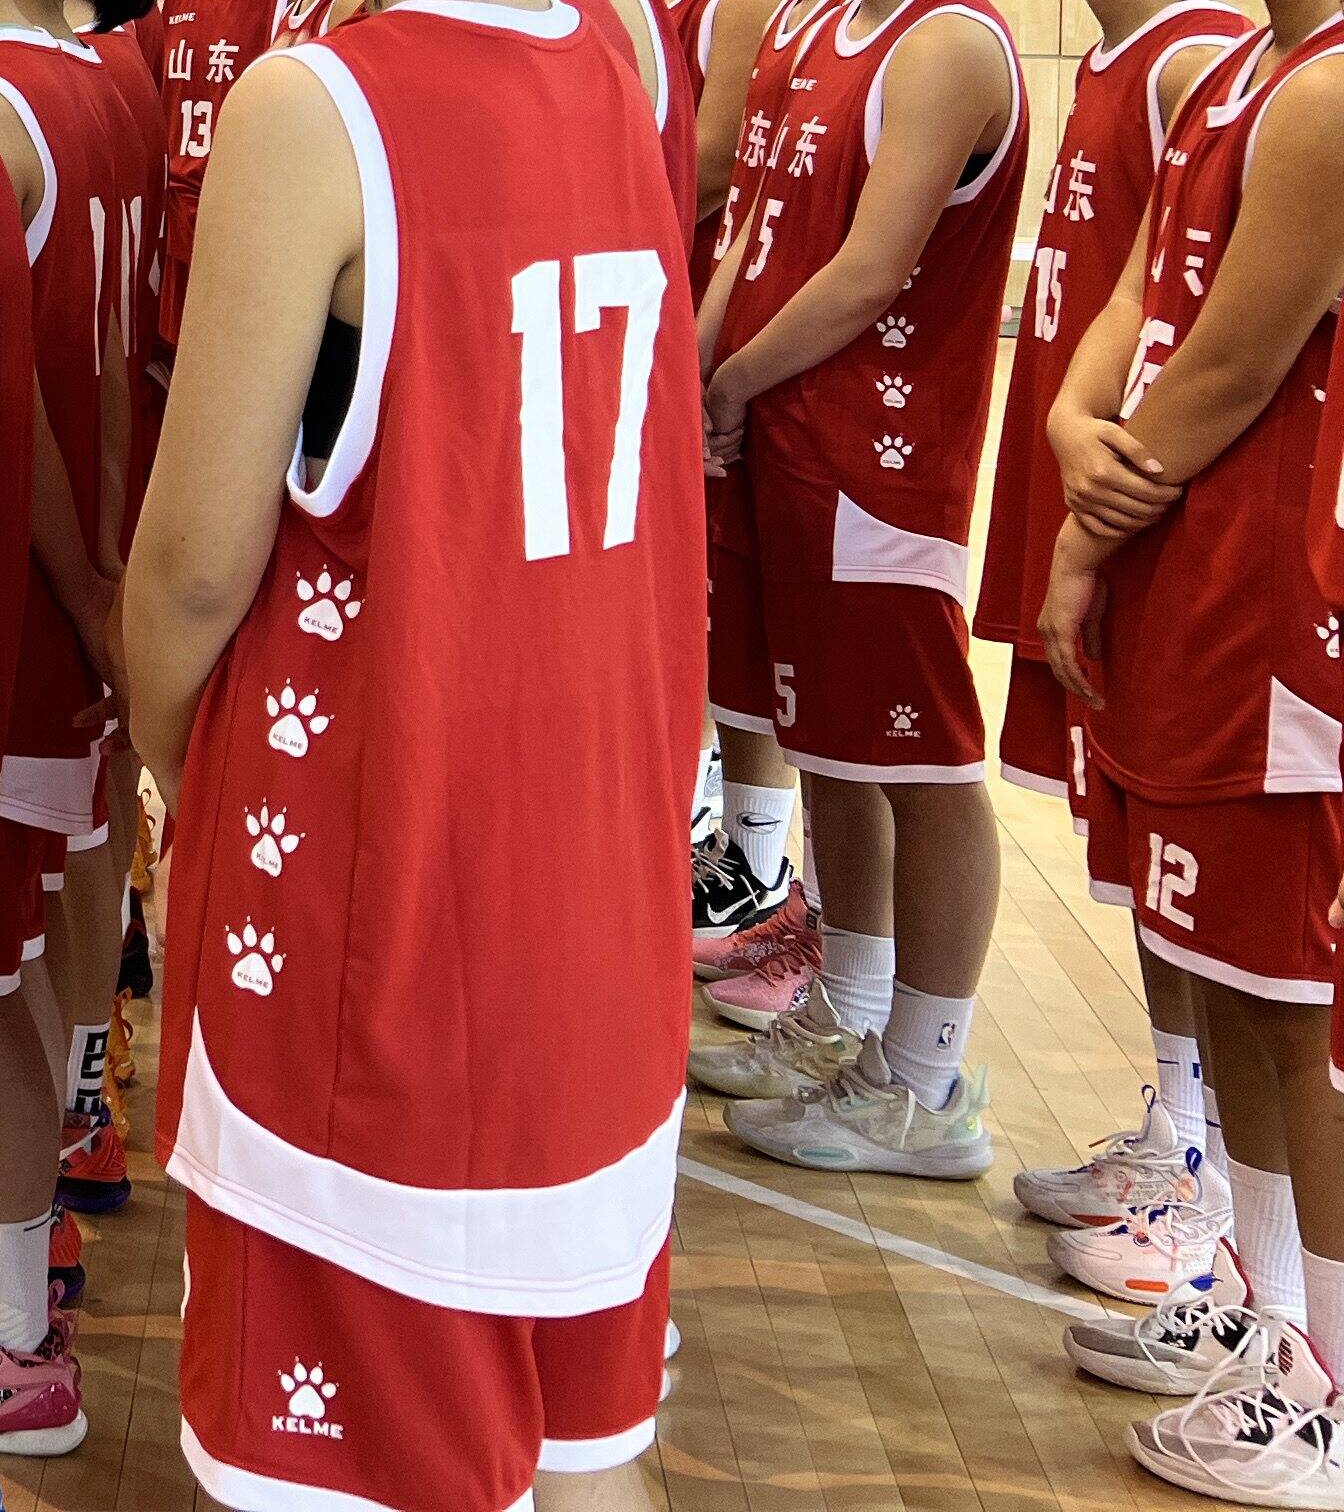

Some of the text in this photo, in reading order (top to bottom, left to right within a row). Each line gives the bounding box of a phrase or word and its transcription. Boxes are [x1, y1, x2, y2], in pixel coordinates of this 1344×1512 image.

[167, 38, 240, 83] 山东
[179, 99, 213, 158] 13
[744, 198, 785, 282] 5
[510, 248, 669, 562] 17
[773, 662, 797, 728] 5
[1145, 832, 1200, 932] 12
[271, 1414, 344, 1440] KELME
